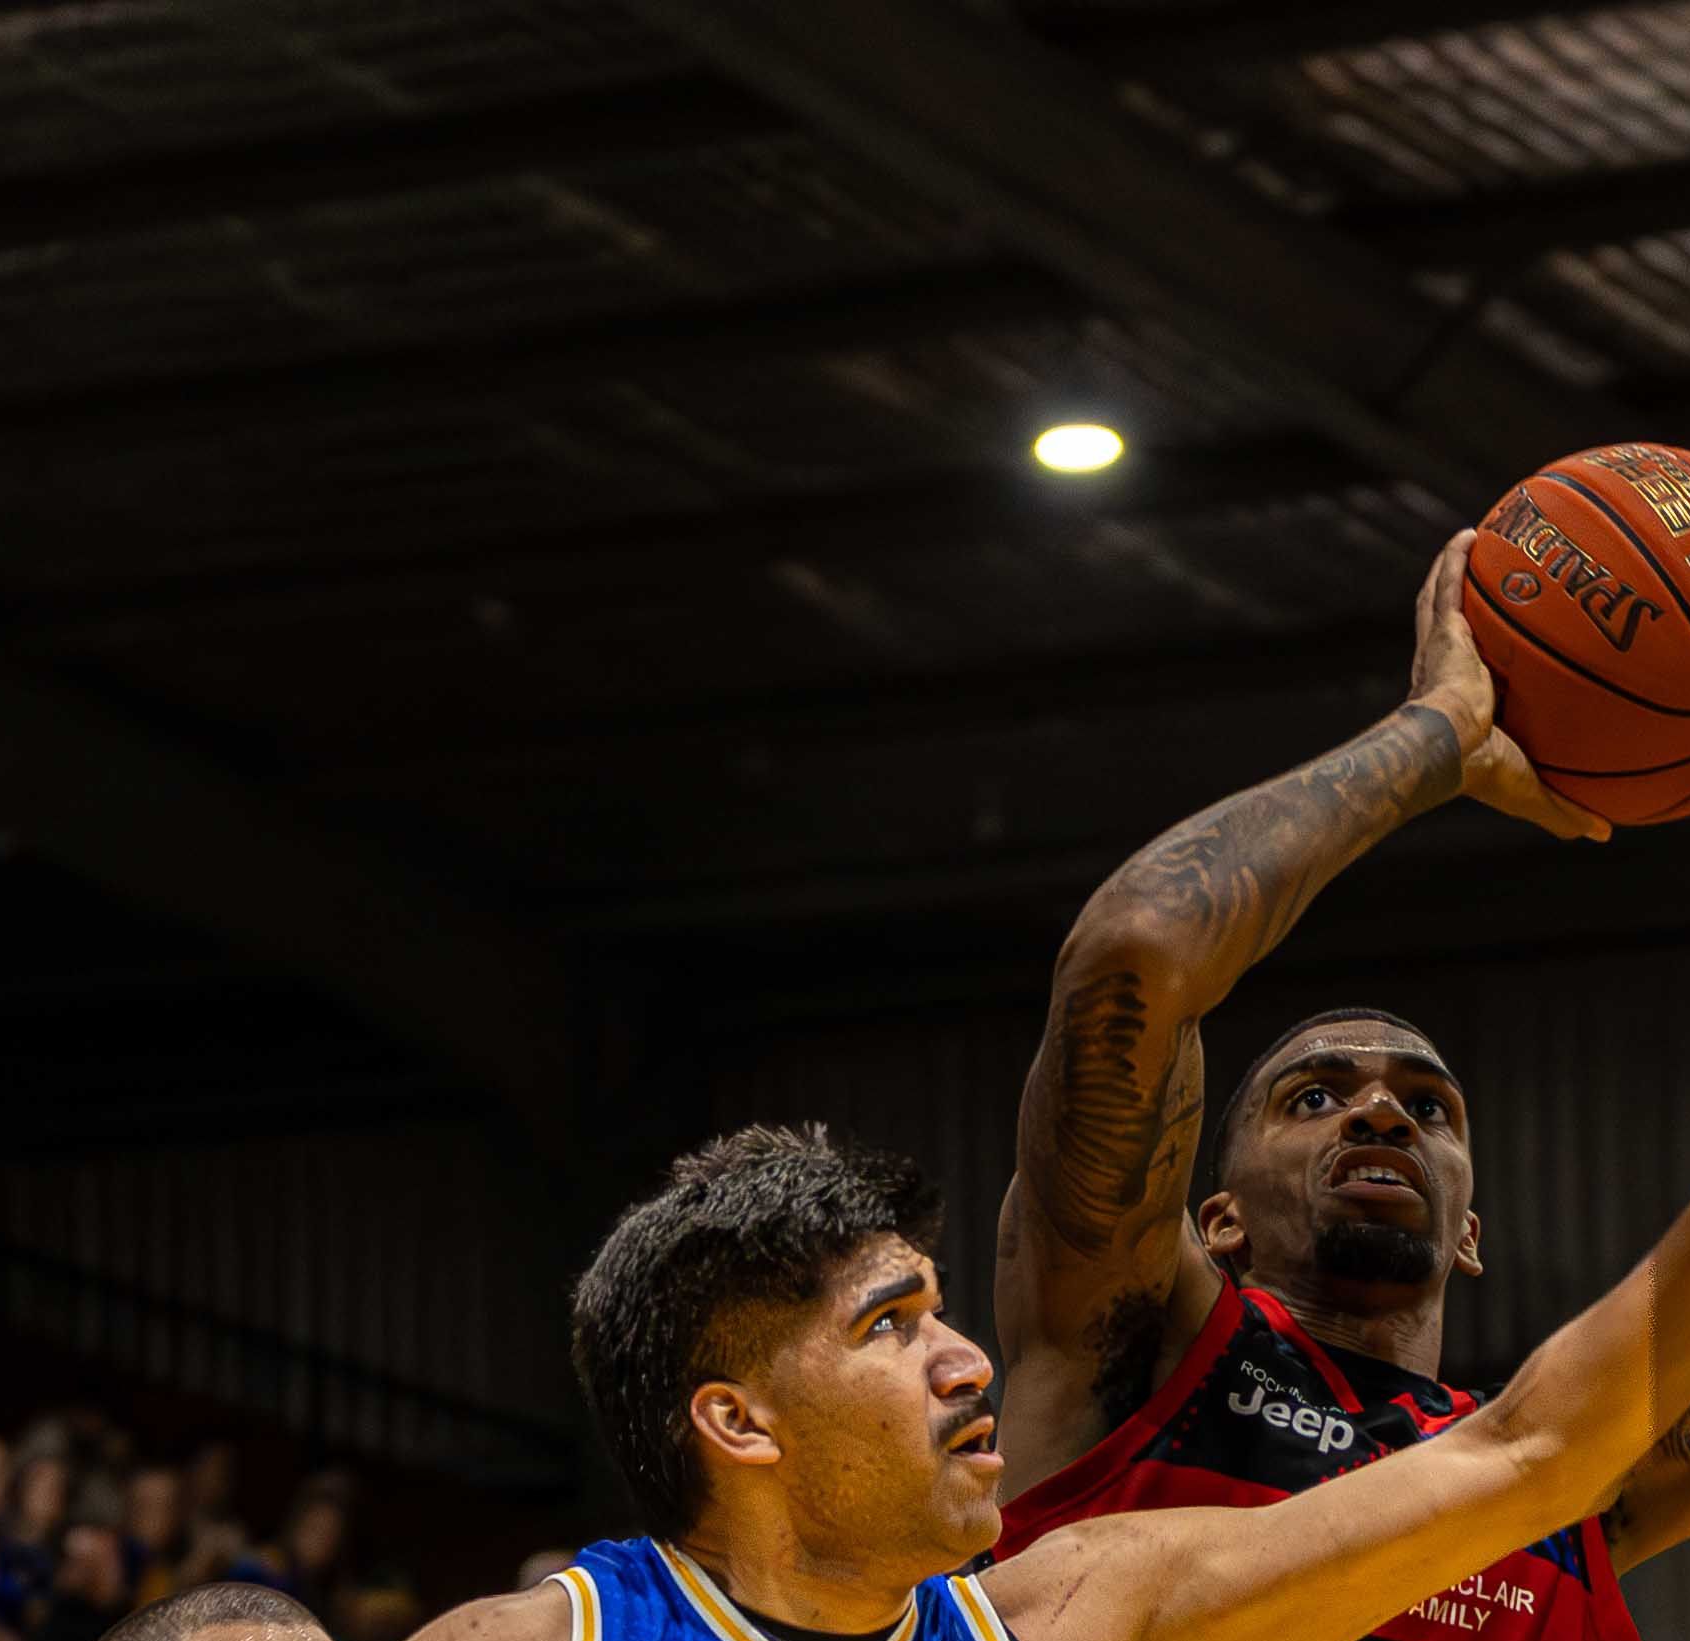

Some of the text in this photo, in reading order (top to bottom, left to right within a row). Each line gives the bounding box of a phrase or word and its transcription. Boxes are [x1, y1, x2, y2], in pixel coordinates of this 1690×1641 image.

[1228, 1384, 1355, 1454] Jeep
[1409, 1596, 1491, 1632] AMILY
[1451, 1574, 1535, 1615] CLAIR
